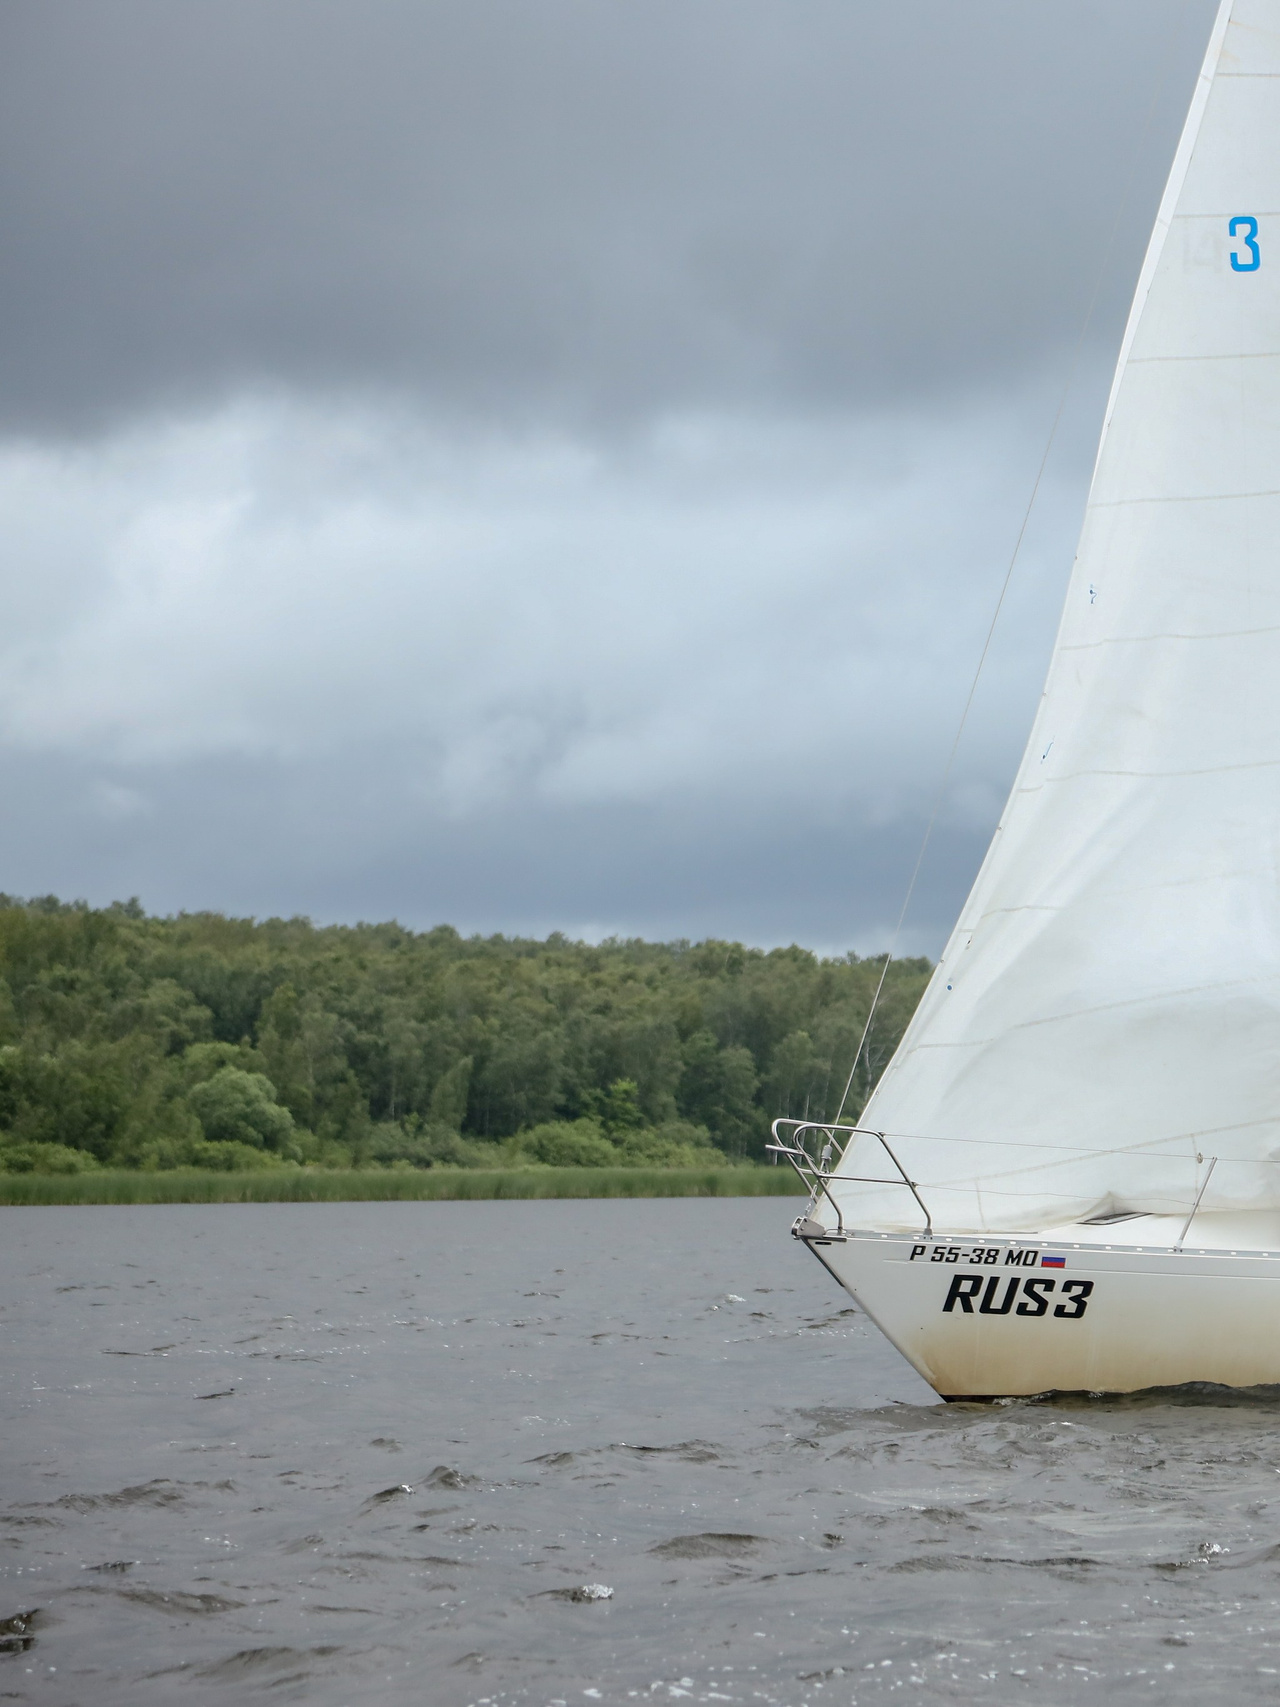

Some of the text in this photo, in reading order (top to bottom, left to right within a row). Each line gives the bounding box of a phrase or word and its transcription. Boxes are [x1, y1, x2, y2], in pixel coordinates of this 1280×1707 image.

[1228, 216, 1260, 272] 3
[930, 1246, 999, 1265] 55-38
[942, 1274, 1094, 1319] RUS3
